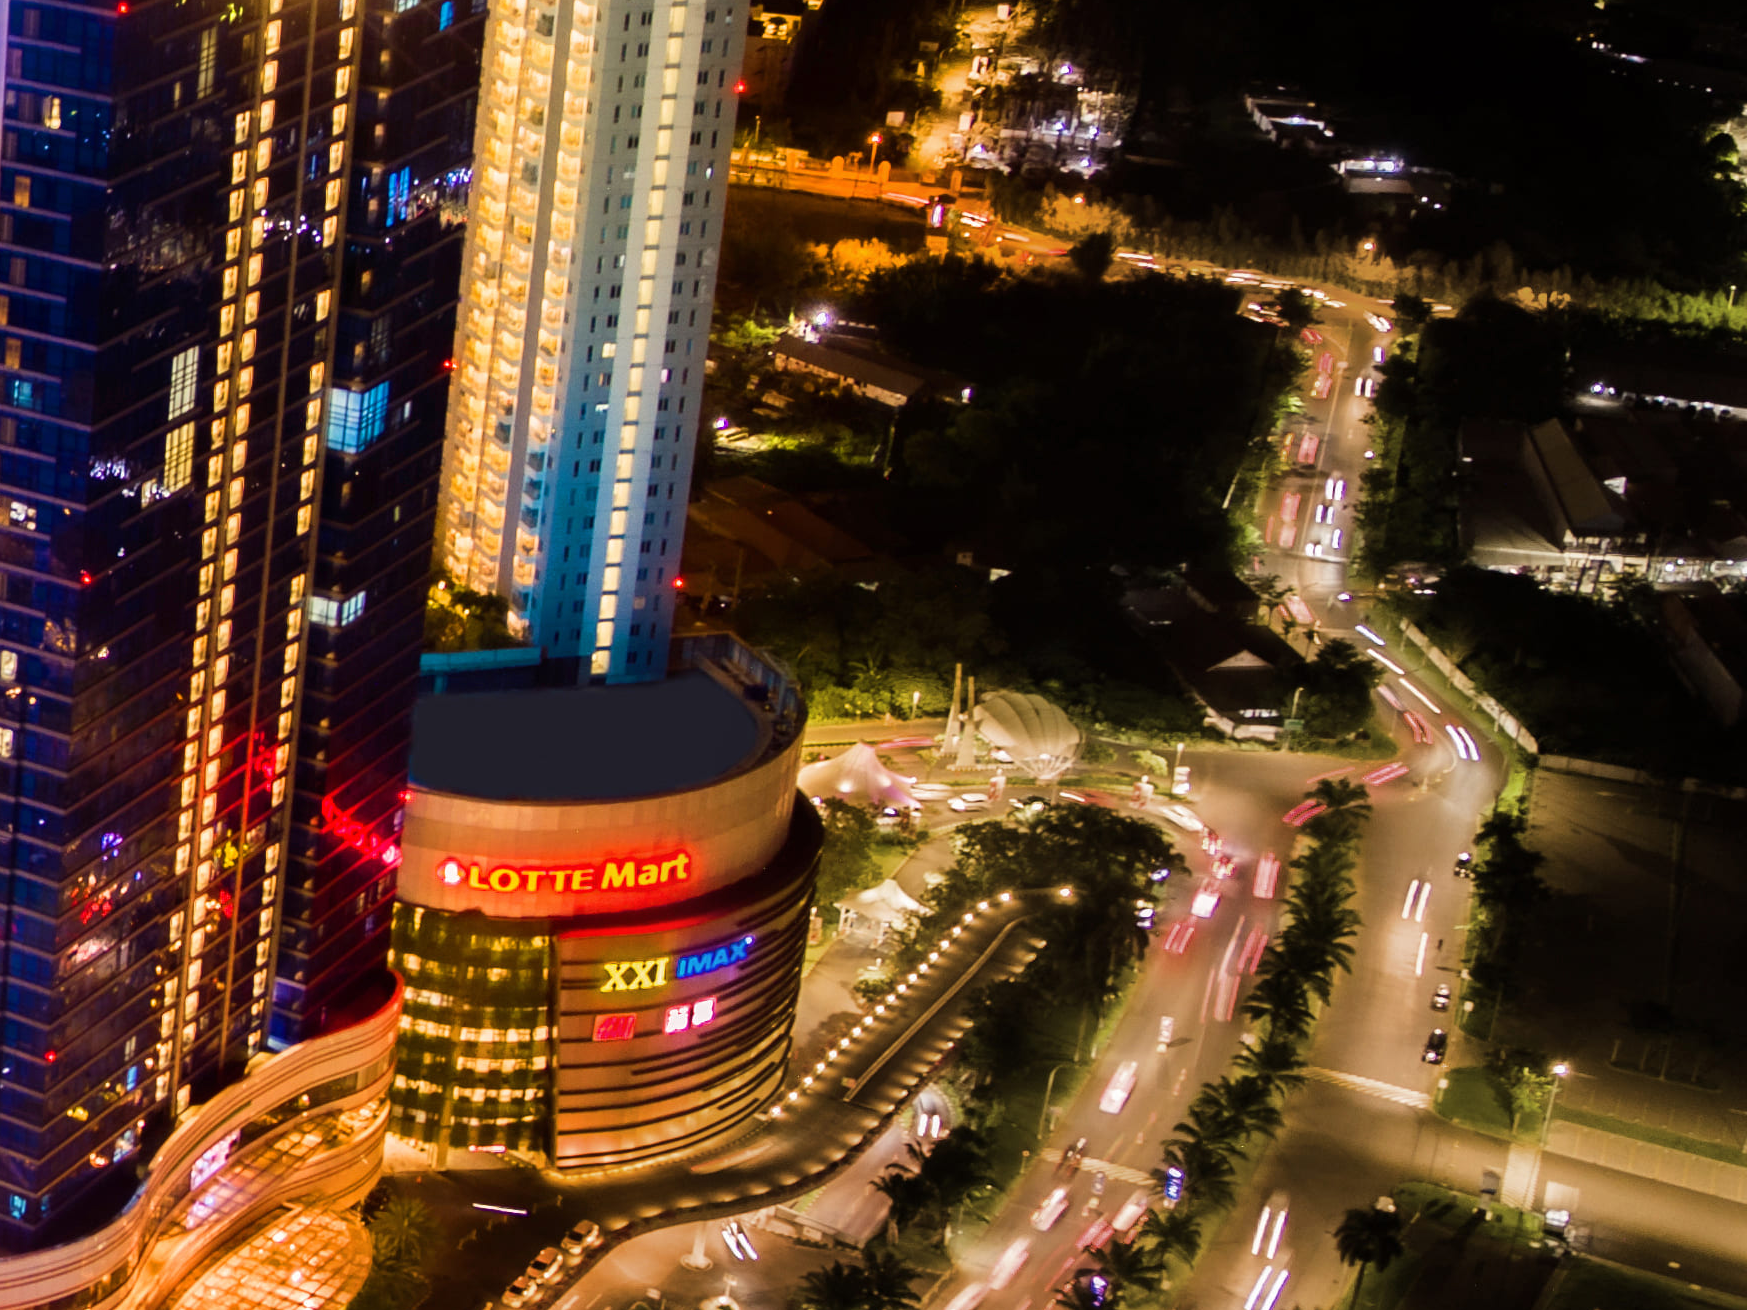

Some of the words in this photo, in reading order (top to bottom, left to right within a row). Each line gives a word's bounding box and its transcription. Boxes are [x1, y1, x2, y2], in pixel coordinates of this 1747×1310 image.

[468, 864, 595, 894] LOTTE
[600, 851, 691, 890] Mart
[600, 956, 670, 994] XXI
[675, 941, 749, 980] IMAX
